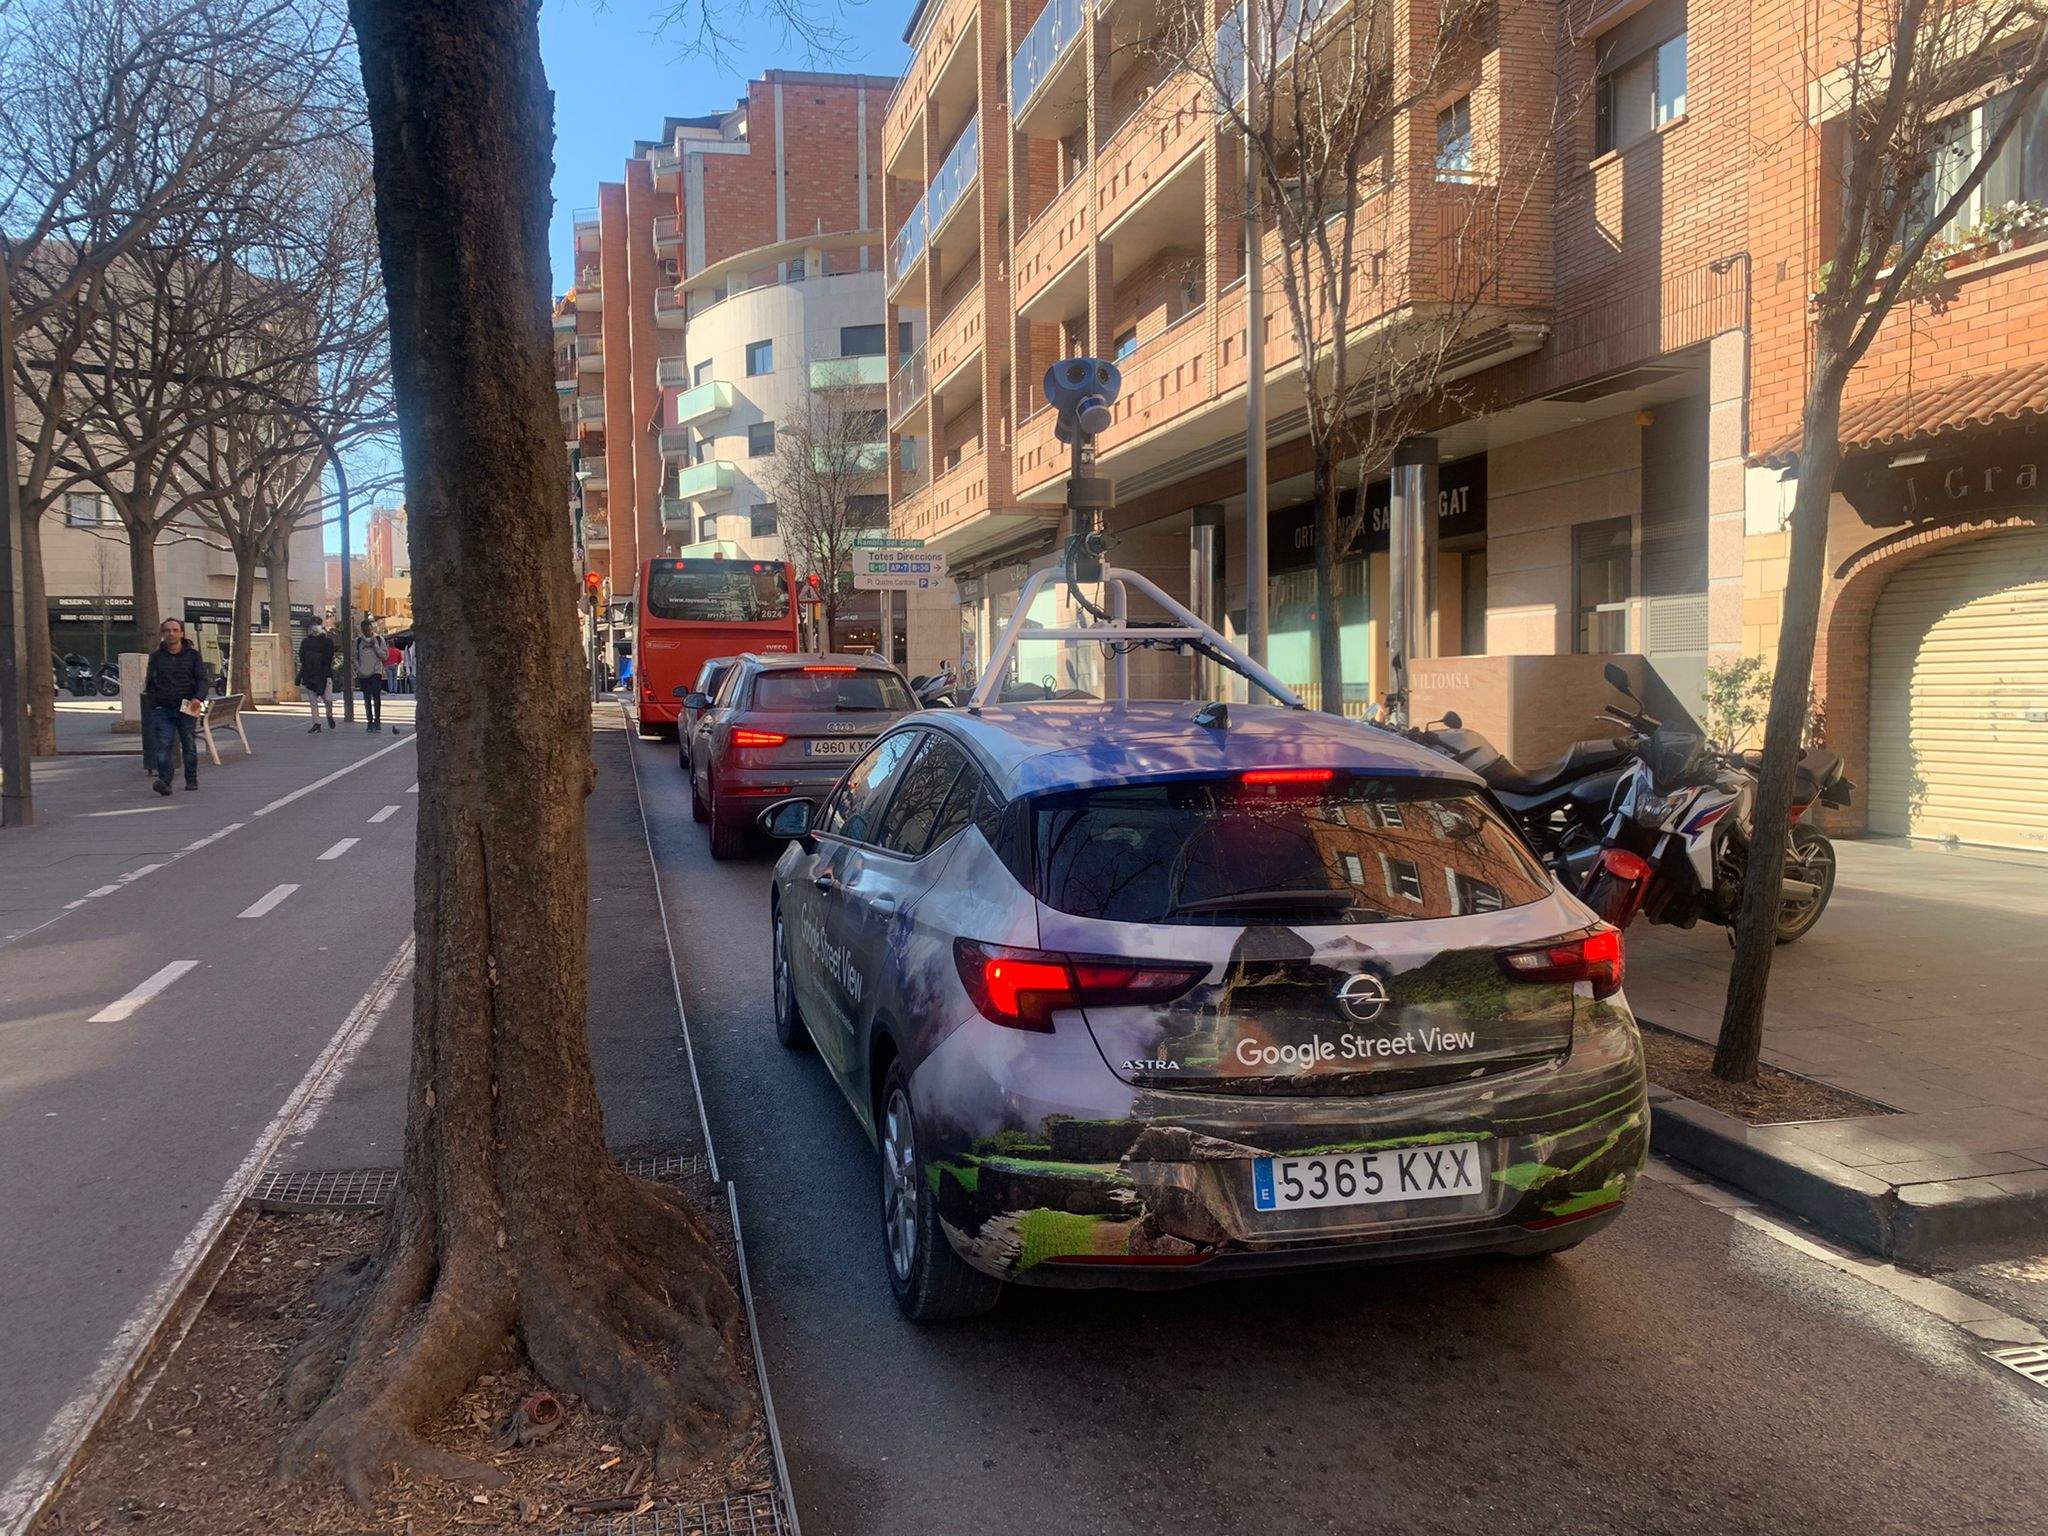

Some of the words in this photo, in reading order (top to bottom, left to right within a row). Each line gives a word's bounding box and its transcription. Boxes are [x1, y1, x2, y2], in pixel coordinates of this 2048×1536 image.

[868, 552, 894, 561] Totes
[897, 552, 943, 561] Direccions
[890, 563, 908, 571] AP-7
[912, 563, 930, 571] B-30
[761, 610, 783, 618] 2624
[815, 741, 846, 754] 4960
[1236, 1034, 1335, 1069] Google
[1340, 1031, 1416, 1059] Street
[1418, 1027, 1476, 1052] View
[1121, 1059, 1180, 1071] ASTRA
[1282, 1156, 1384, 1202] 5365
[1398, 1148, 1474, 1193] KXX
[1262, 1188, 1270, 1200] E
